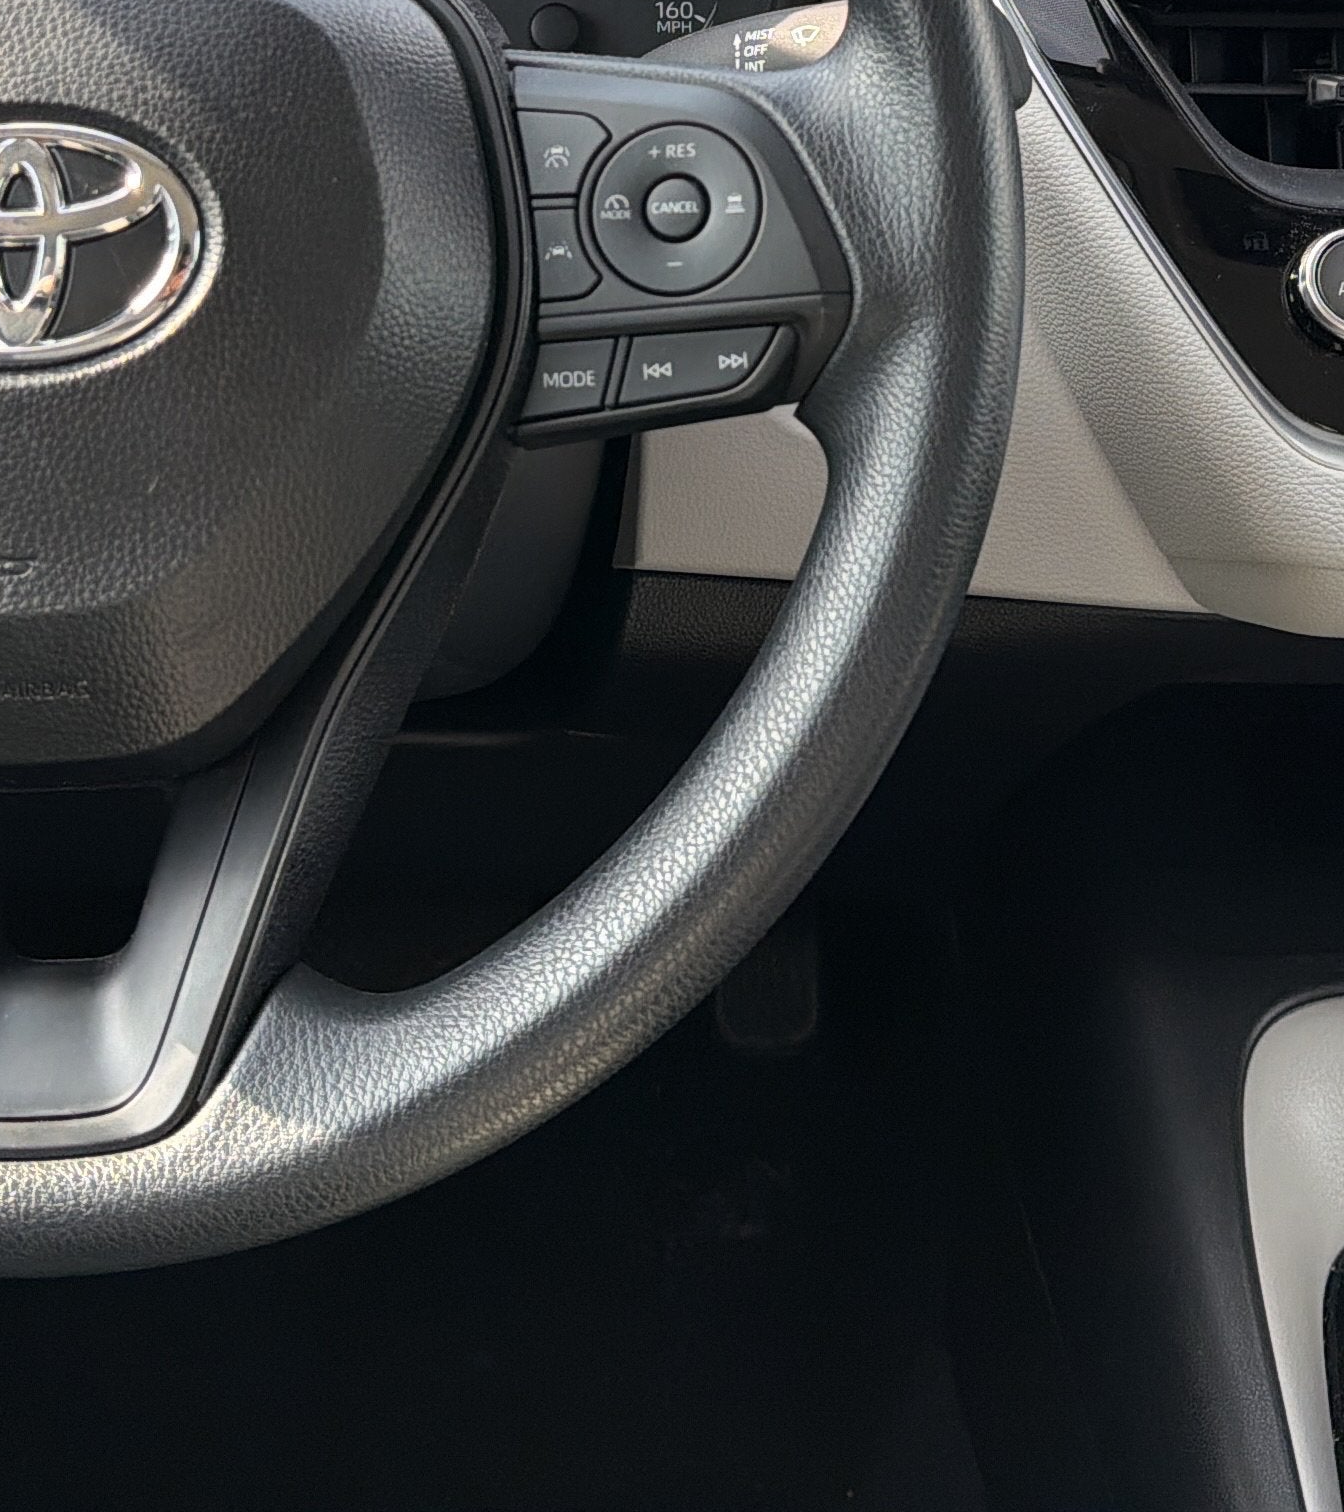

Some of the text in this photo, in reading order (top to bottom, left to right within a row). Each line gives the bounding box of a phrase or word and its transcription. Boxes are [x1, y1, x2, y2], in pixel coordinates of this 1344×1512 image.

[655, 1, 693, 19] 160
[656, 20, 692, 34] MPH
[744, 27, 774, 42] MIST
[744, 43, 768, 57] OFF
[744, 60, 766, 72] INT
[665, 143, 696, 159] RES
[651, 200, 699, 215] CANCEL
[543, 369, 596, 388] MODE
